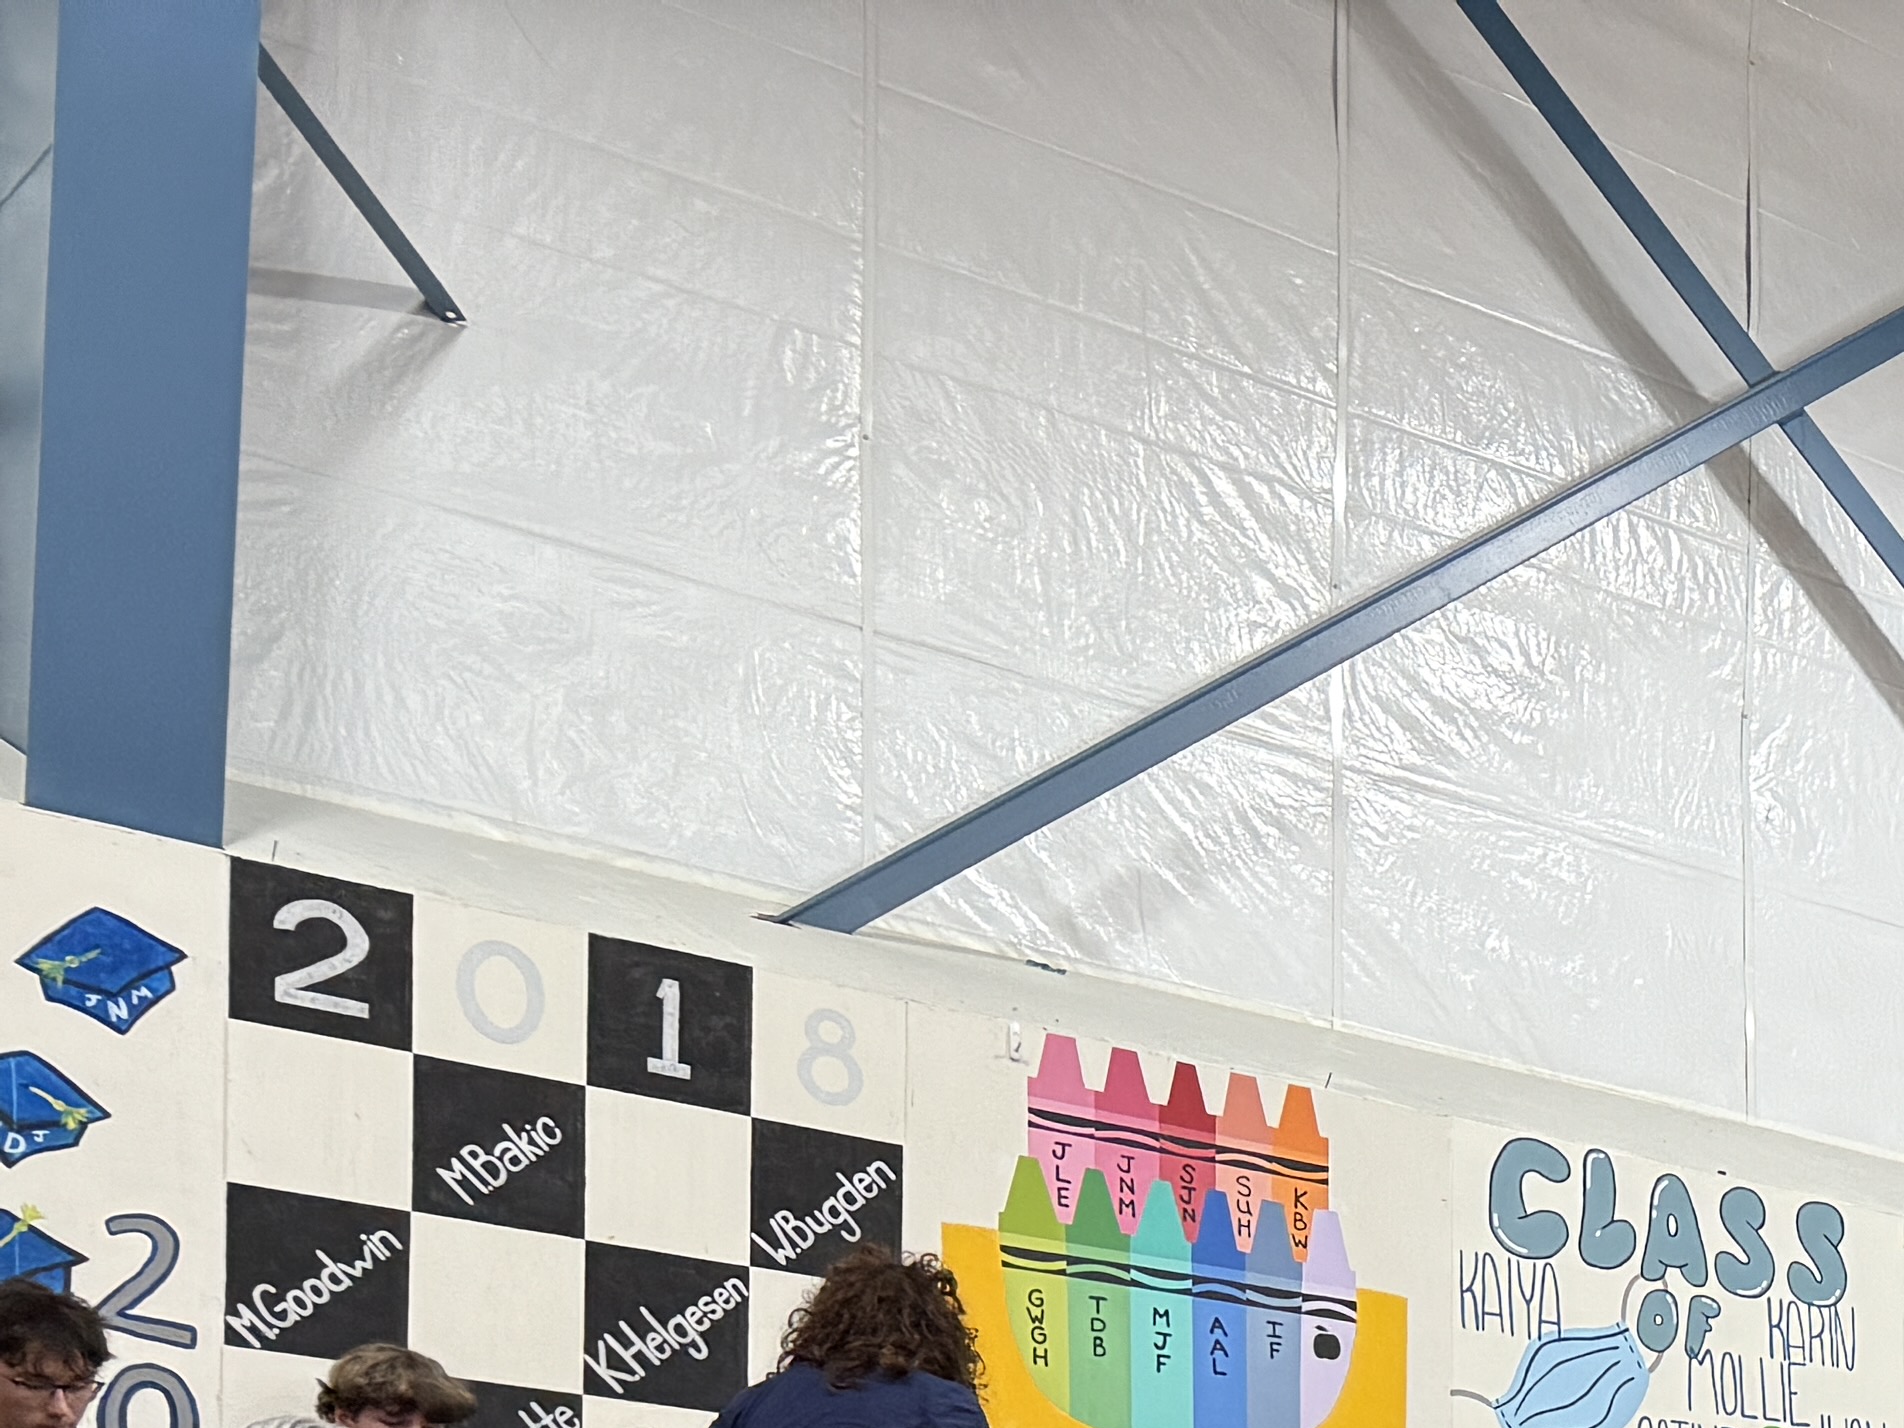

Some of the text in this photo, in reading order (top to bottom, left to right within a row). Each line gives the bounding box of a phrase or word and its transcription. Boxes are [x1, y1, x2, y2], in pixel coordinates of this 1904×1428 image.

[436, 1114, 563, 1207] M.Bakic
[751, 1155, 897, 1268] W.Bugden
[1489, 1138, 1847, 1306] CLASS
[225, 1225, 403, 1351] M.Goodwin
[1459, 1250, 1563, 1340] KAIYA
[1637, 1289, 1720, 1358] OF
[1766, 1297, 1856, 1371] KARIN
[584, 1274, 750, 1396] K.Helgesen
[1687, 1350, 1810, 1427] MOLLIE
